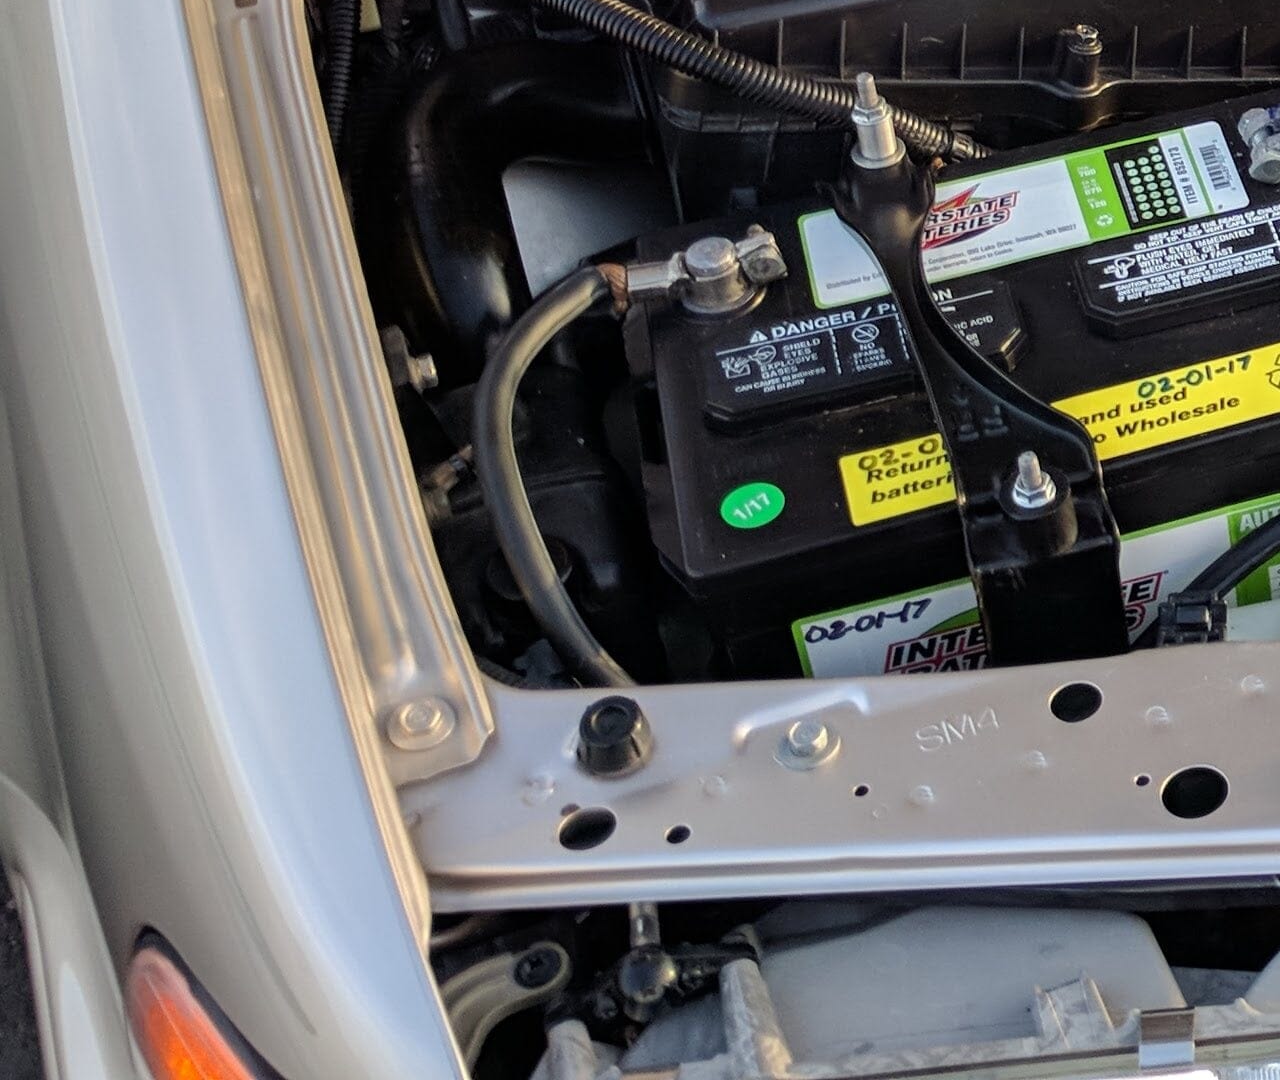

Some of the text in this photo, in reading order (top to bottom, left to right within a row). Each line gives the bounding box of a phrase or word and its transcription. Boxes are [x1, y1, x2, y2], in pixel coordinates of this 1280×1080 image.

[1182, 184, 1199, 205] ITEM
[1193, 226, 1256, 248] IMMEDIATELY
[1139, 246, 1235, 275] MEDICAL HELP FAST
[769, 309, 857, 338] DANGER
[1137, 354, 1253, 400] 02-01-17
[1128, 387, 1189, 414] used
[1116, 395, 1242, 440] Wholesale
[732, 492, 772, 522] 1/17
